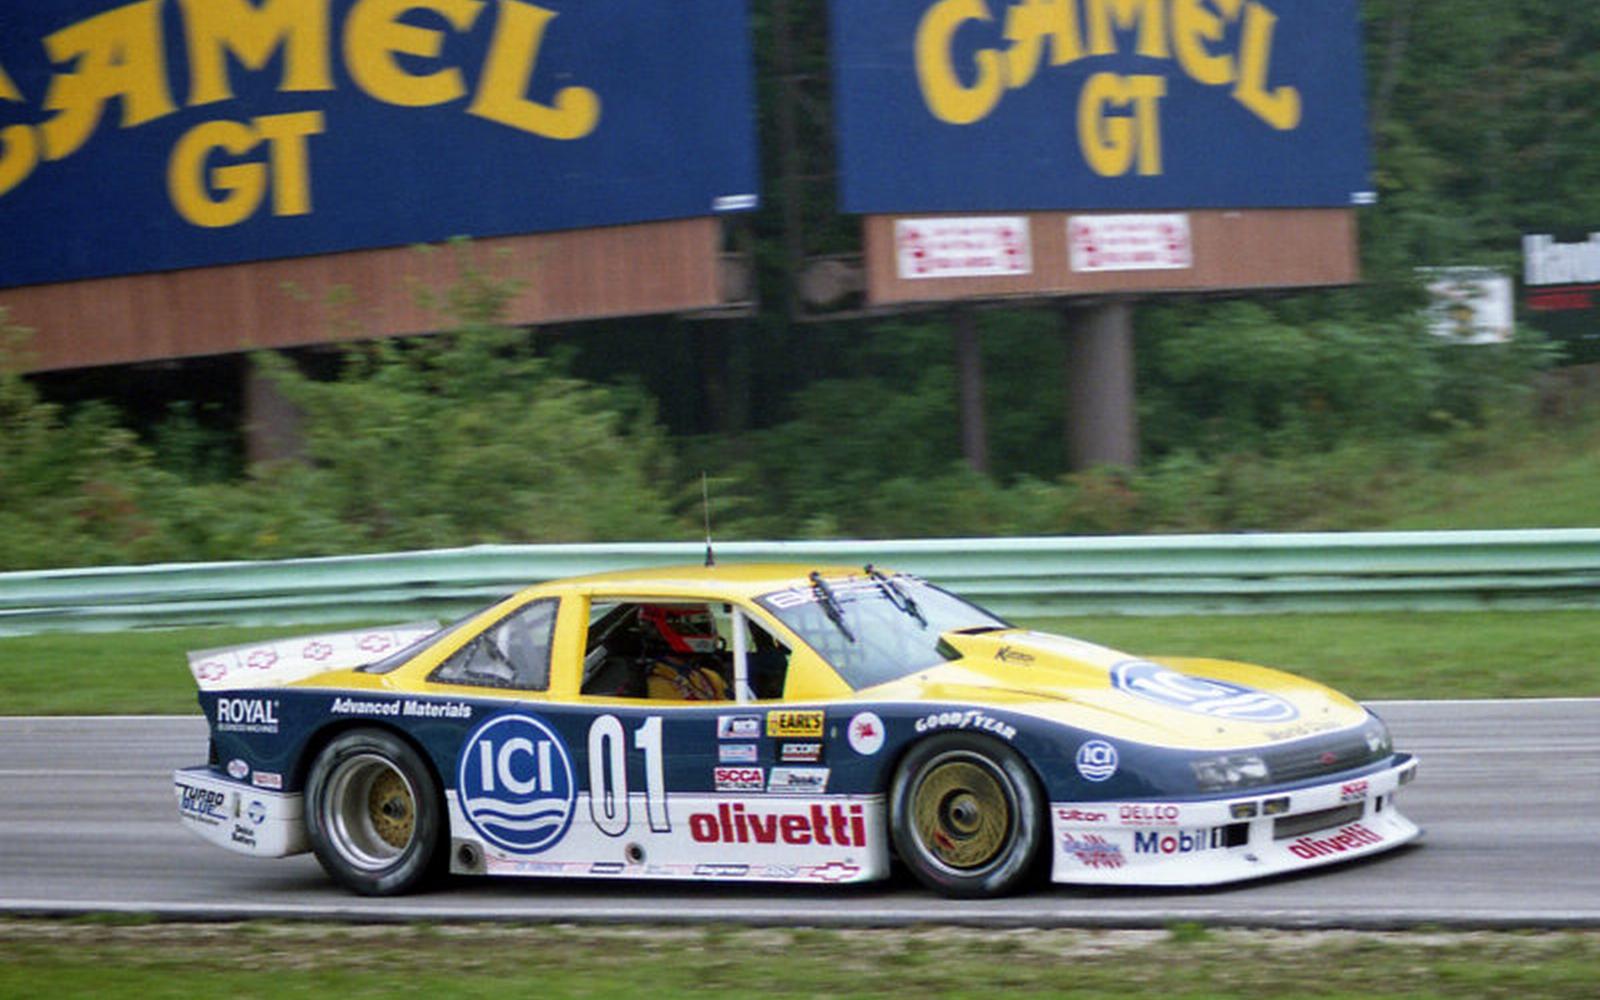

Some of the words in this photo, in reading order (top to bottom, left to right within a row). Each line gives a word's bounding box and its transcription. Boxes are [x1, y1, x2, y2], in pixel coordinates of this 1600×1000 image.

[915, 0, 1301, 131] CAMEL
[0, 0, 600, 197] AMEL
[1076, 72, 1167, 177] GT
[168, 111, 326, 228] GT
[217, 698, 278, 723] ROYAL
[331, 698, 400, 715] Advanced
[403, 701, 472, 718] Materials
[914, 710, 1017, 740] GOODYEAR
[479, 737, 553, 795] ICI
[1082, 747, 1112, 764] ICI
[588, 714, 671, 837] 01
[716, 770, 762, 782] SCCA
[175, 782, 224, 806] TURBO
[689, 802, 866, 847] olivetti
[1119, 805, 1179, 819] DELCO
[1134, 829, 1206, 854] Mobil
[1288, 823, 1384, 860] olivetti
